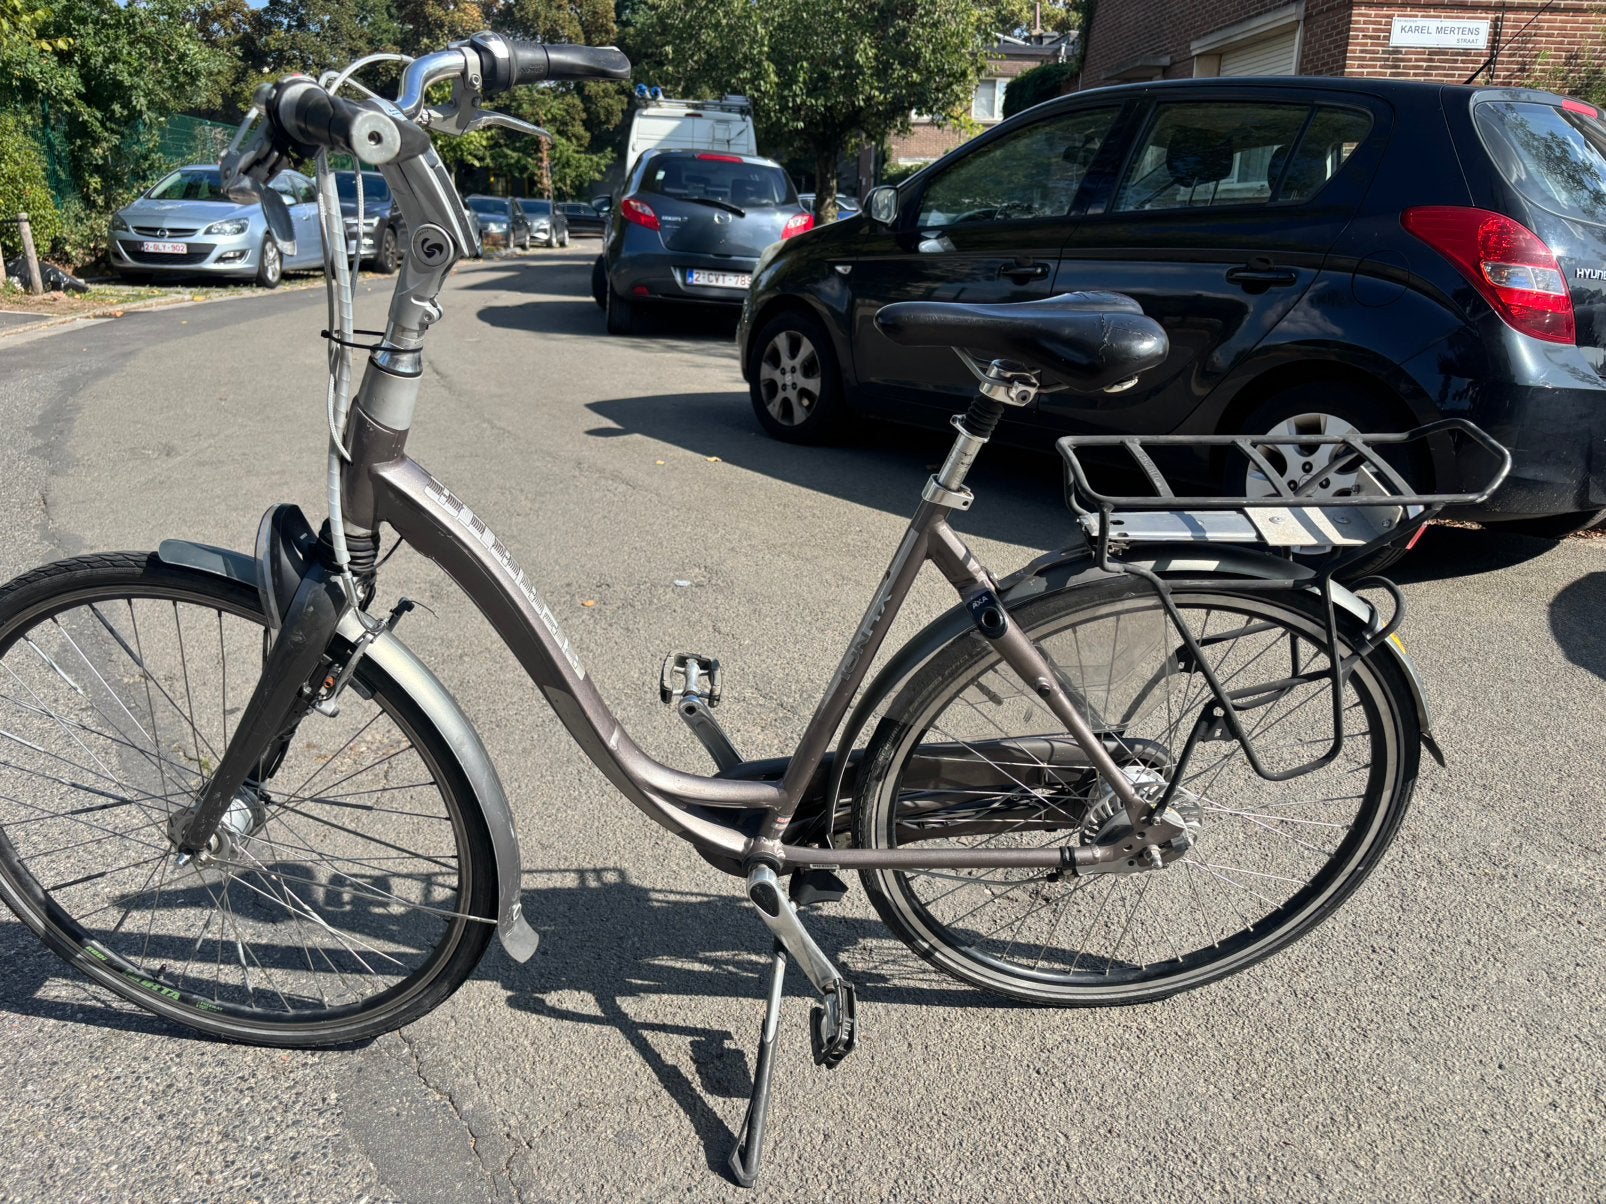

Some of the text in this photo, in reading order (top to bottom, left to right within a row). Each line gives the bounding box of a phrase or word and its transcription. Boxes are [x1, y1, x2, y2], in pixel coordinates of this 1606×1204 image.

[1400, 25, 1480, 36] KAREL MERTENS
[972, 595, 989, 609] AXA
